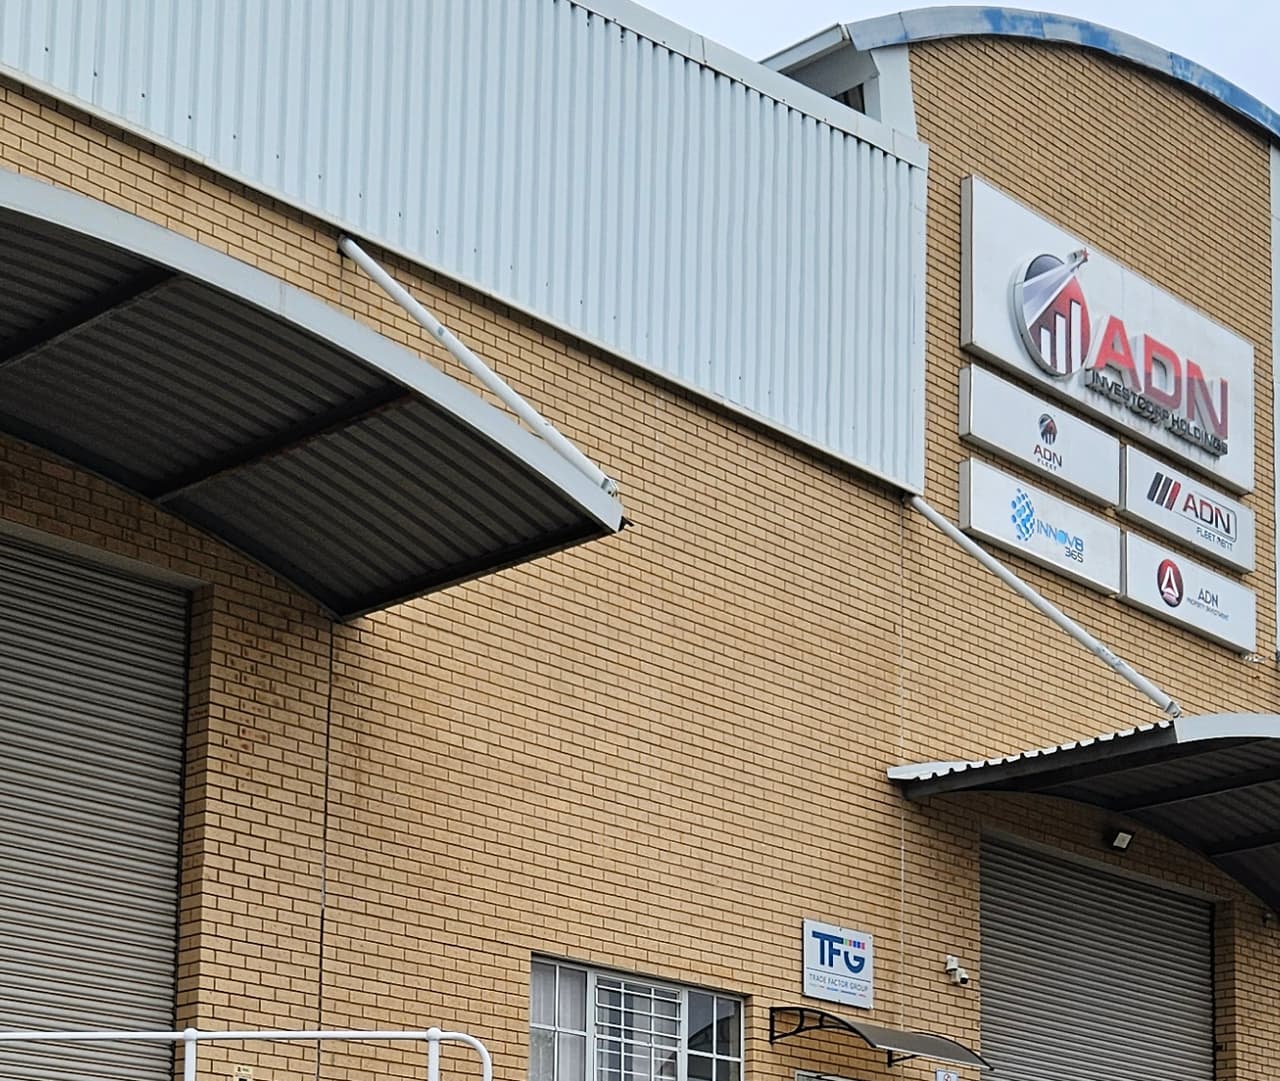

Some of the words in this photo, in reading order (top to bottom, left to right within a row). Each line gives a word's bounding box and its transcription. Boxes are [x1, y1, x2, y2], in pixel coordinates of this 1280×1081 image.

[1093, 314, 1229, 441] ADN
[1091, 370, 1170, 422] INVESTCORP
[1033, 444, 1063, 468] ADN
[1182, 493, 1232, 535] ADN
[1035, 518, 1085, 553] INNOV8
[1064, 545, 1085, 564] 365
[1197, 587, 1220, 609] ADN
[811, 930, 866, 974] TFG
[808, 973, 826, 985] TRADE
